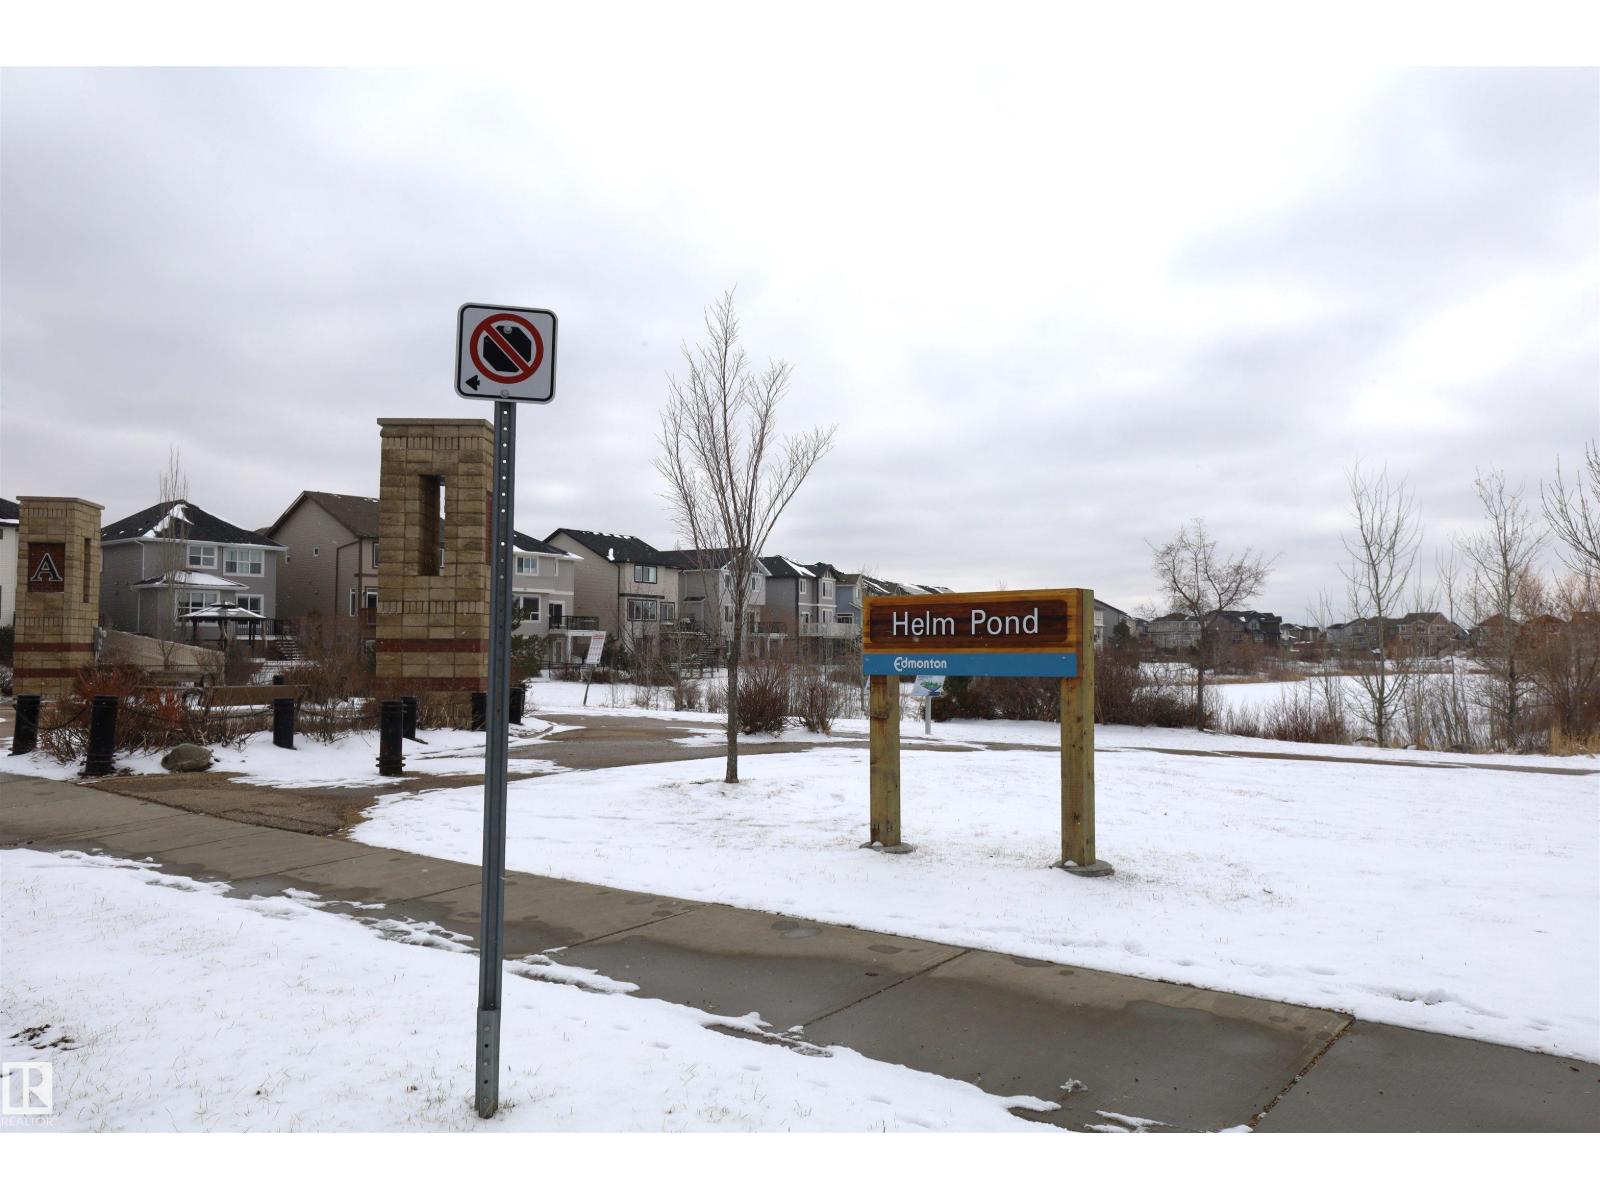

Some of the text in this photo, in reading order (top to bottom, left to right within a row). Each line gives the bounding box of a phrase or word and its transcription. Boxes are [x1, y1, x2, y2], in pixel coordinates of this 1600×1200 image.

[30, 552, 63, 582] A
[892, 608, 1039, 636] Helm Pond
[894, 656, 947, 672] Edmonton
